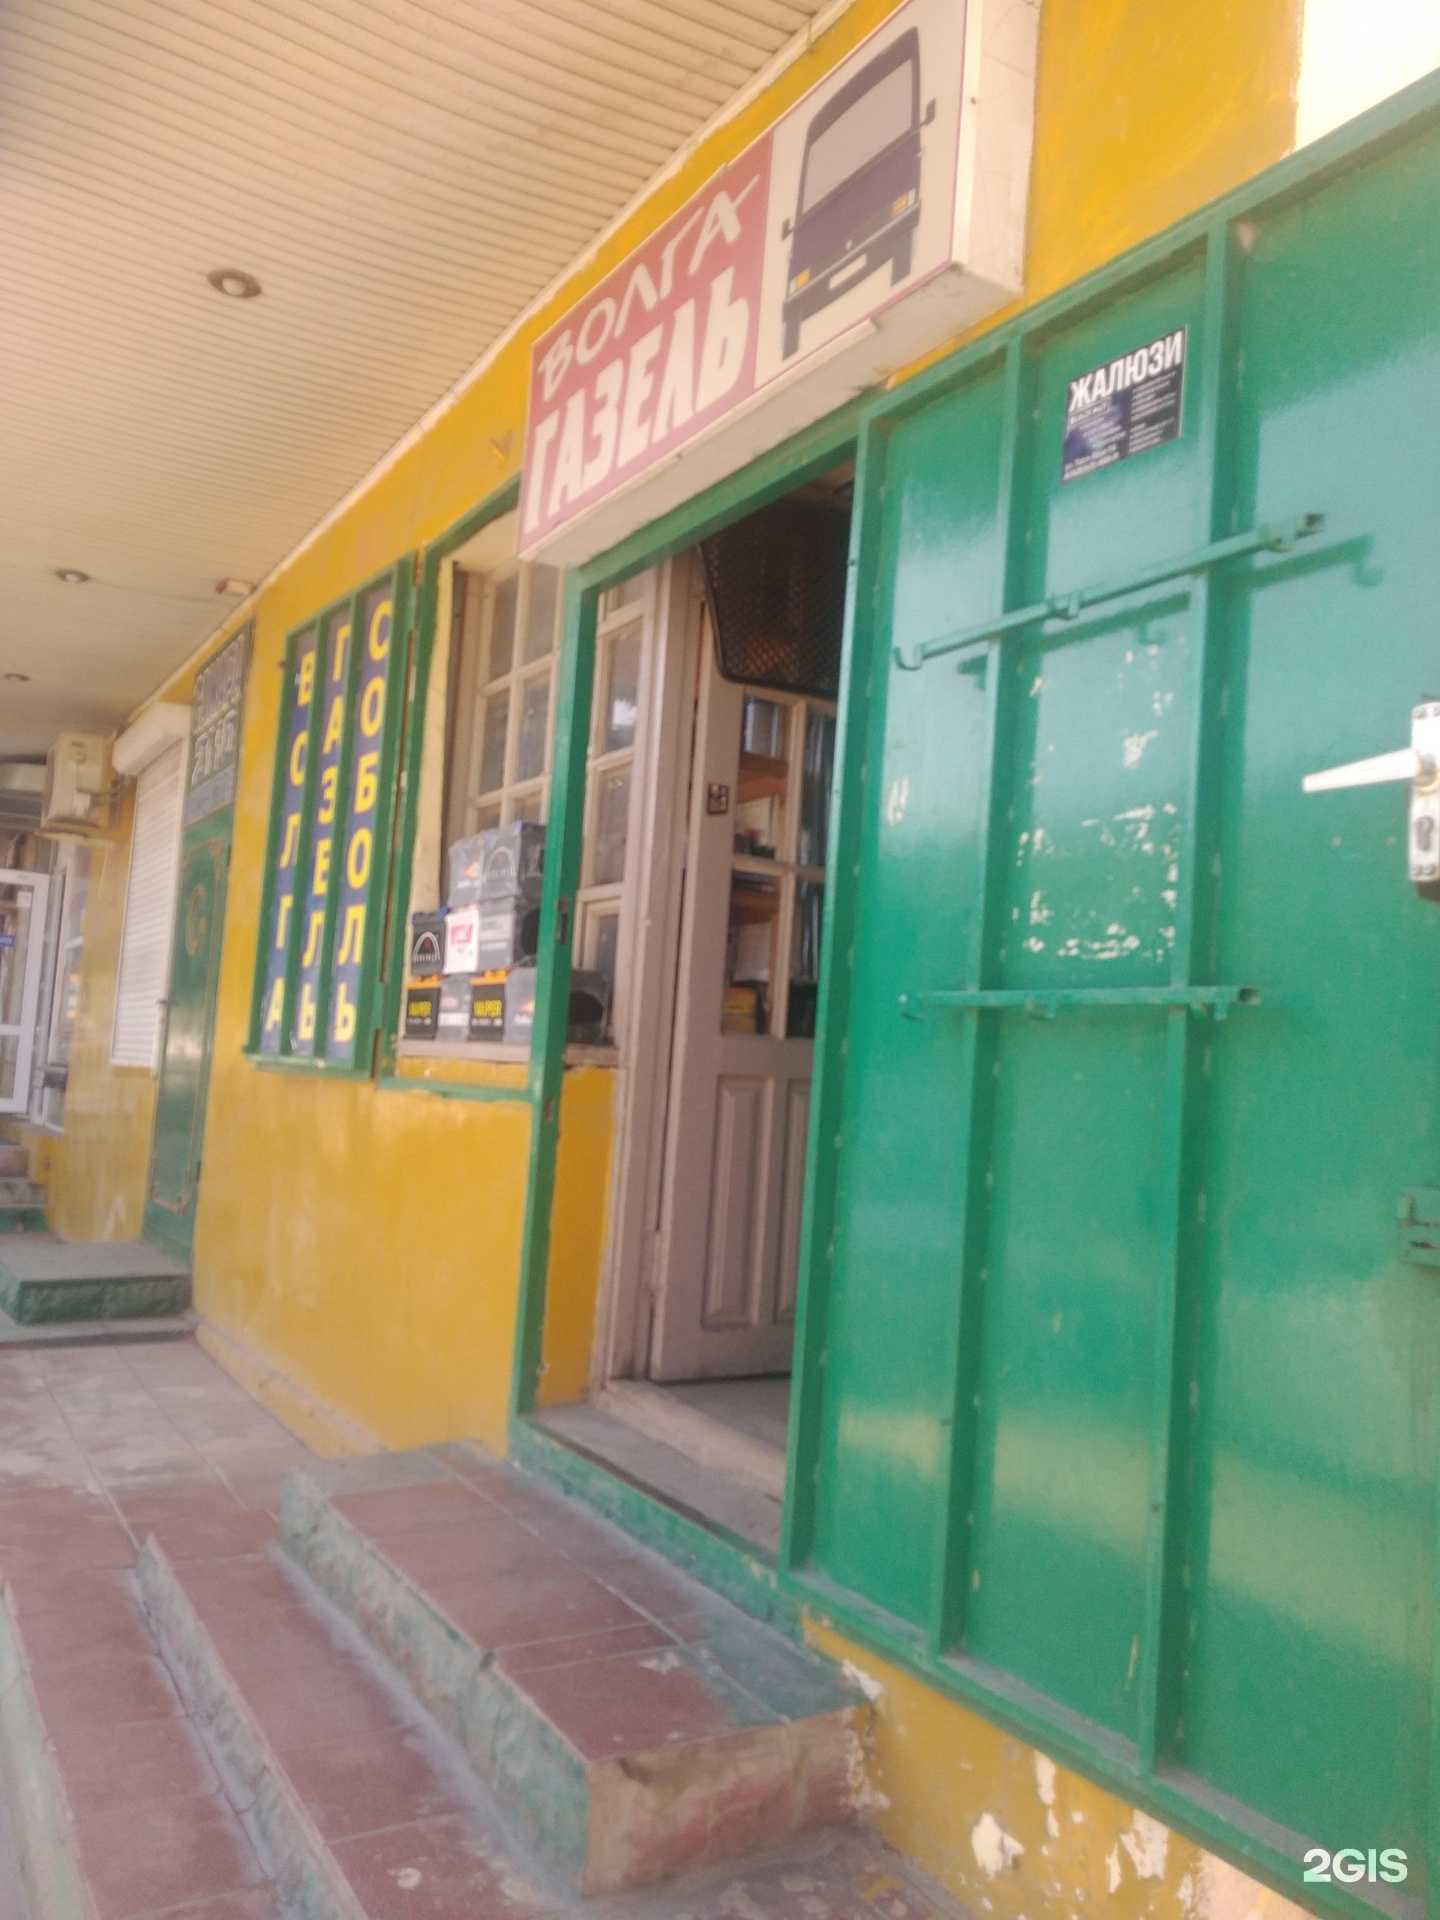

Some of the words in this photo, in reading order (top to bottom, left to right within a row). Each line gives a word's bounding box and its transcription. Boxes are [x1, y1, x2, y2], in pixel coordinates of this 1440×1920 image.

[524, 266, 751, 535] ГАЗЕЛЬ
[537, 174, 760, 403] ВОЛГА
[1069, 329, 1184, 413] ЖАЛЮЗИ
[333, 599, 393, 1043] СОБОЛЬ
